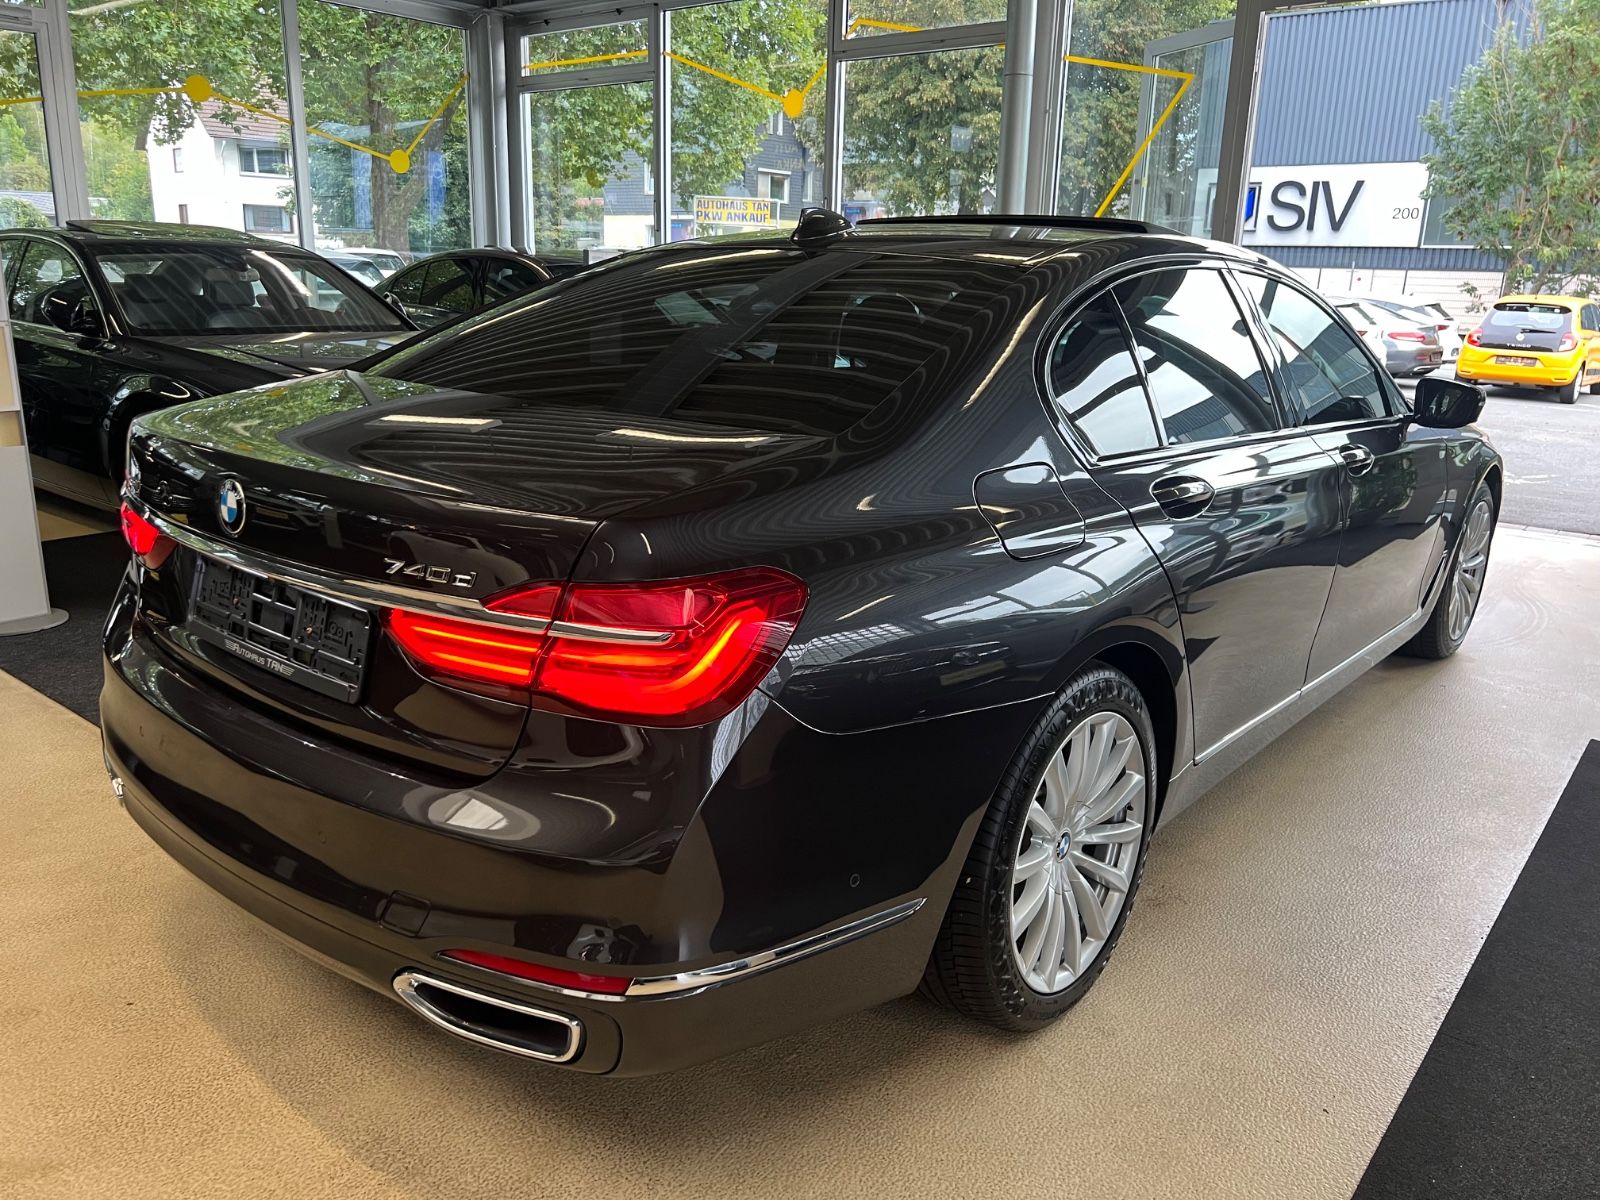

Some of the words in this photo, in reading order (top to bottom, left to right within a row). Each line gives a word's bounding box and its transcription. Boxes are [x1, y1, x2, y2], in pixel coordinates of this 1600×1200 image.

[697, 199, 748, 211] AUTOHAUS
[752, 201, 769, 211] TAN
[1267, 180, 1365, 232] SIV
[696, 211, 722, 221] PKW
[727, 212, 768, 223] ANKAUF
[1392, 207, 1420, 220] 200
[384, 557, 478, 588] 740d
[266, 657, 284, 673] TAN
